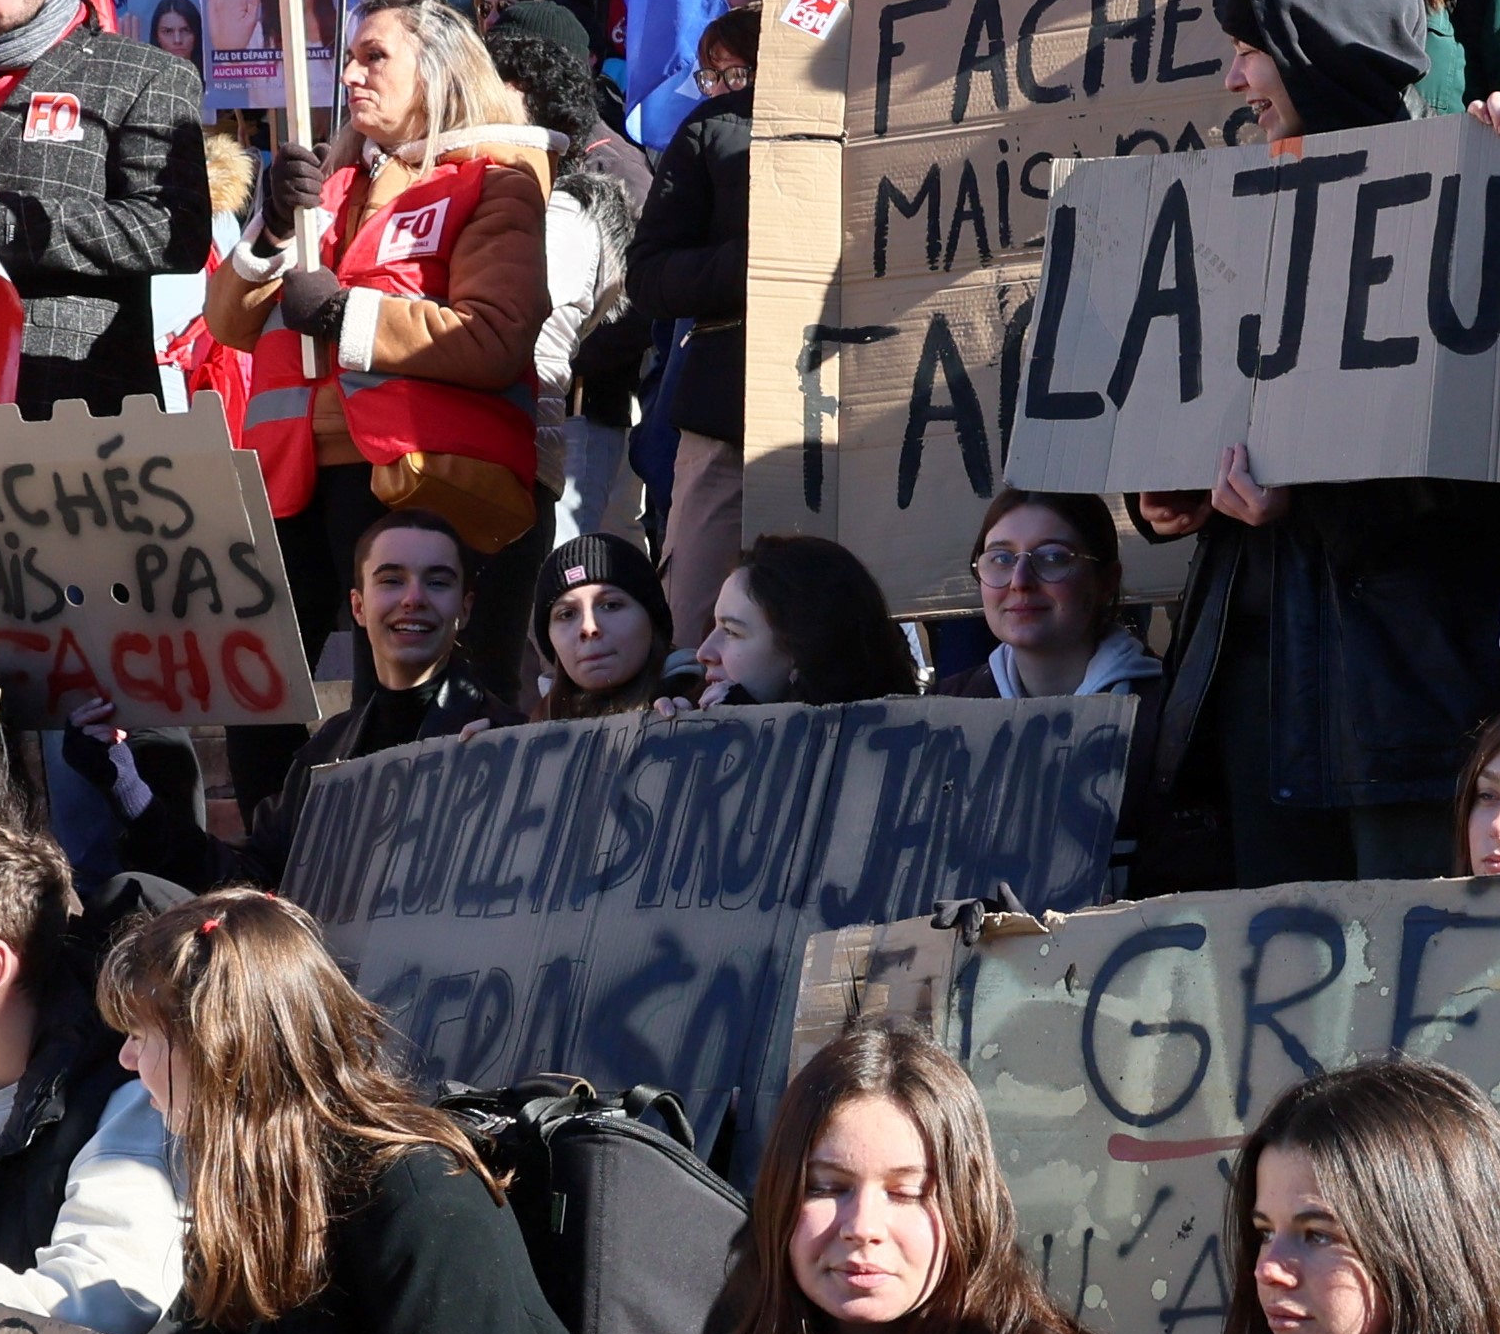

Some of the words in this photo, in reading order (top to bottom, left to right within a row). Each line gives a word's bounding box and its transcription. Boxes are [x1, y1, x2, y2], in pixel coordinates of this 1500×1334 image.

[213, 48, 230, 61] ÂGE
[231, 51, 242, 61] DE
[243, 48, 274, 61] DÉPART
[213, 66, 243, 77] AUCUN
[28, 94, 79, 135] FO
[390, 207, 438, 244] FO
[1022, 177, 1206, 423] LA
[136, 542, 276, 622] PAS
